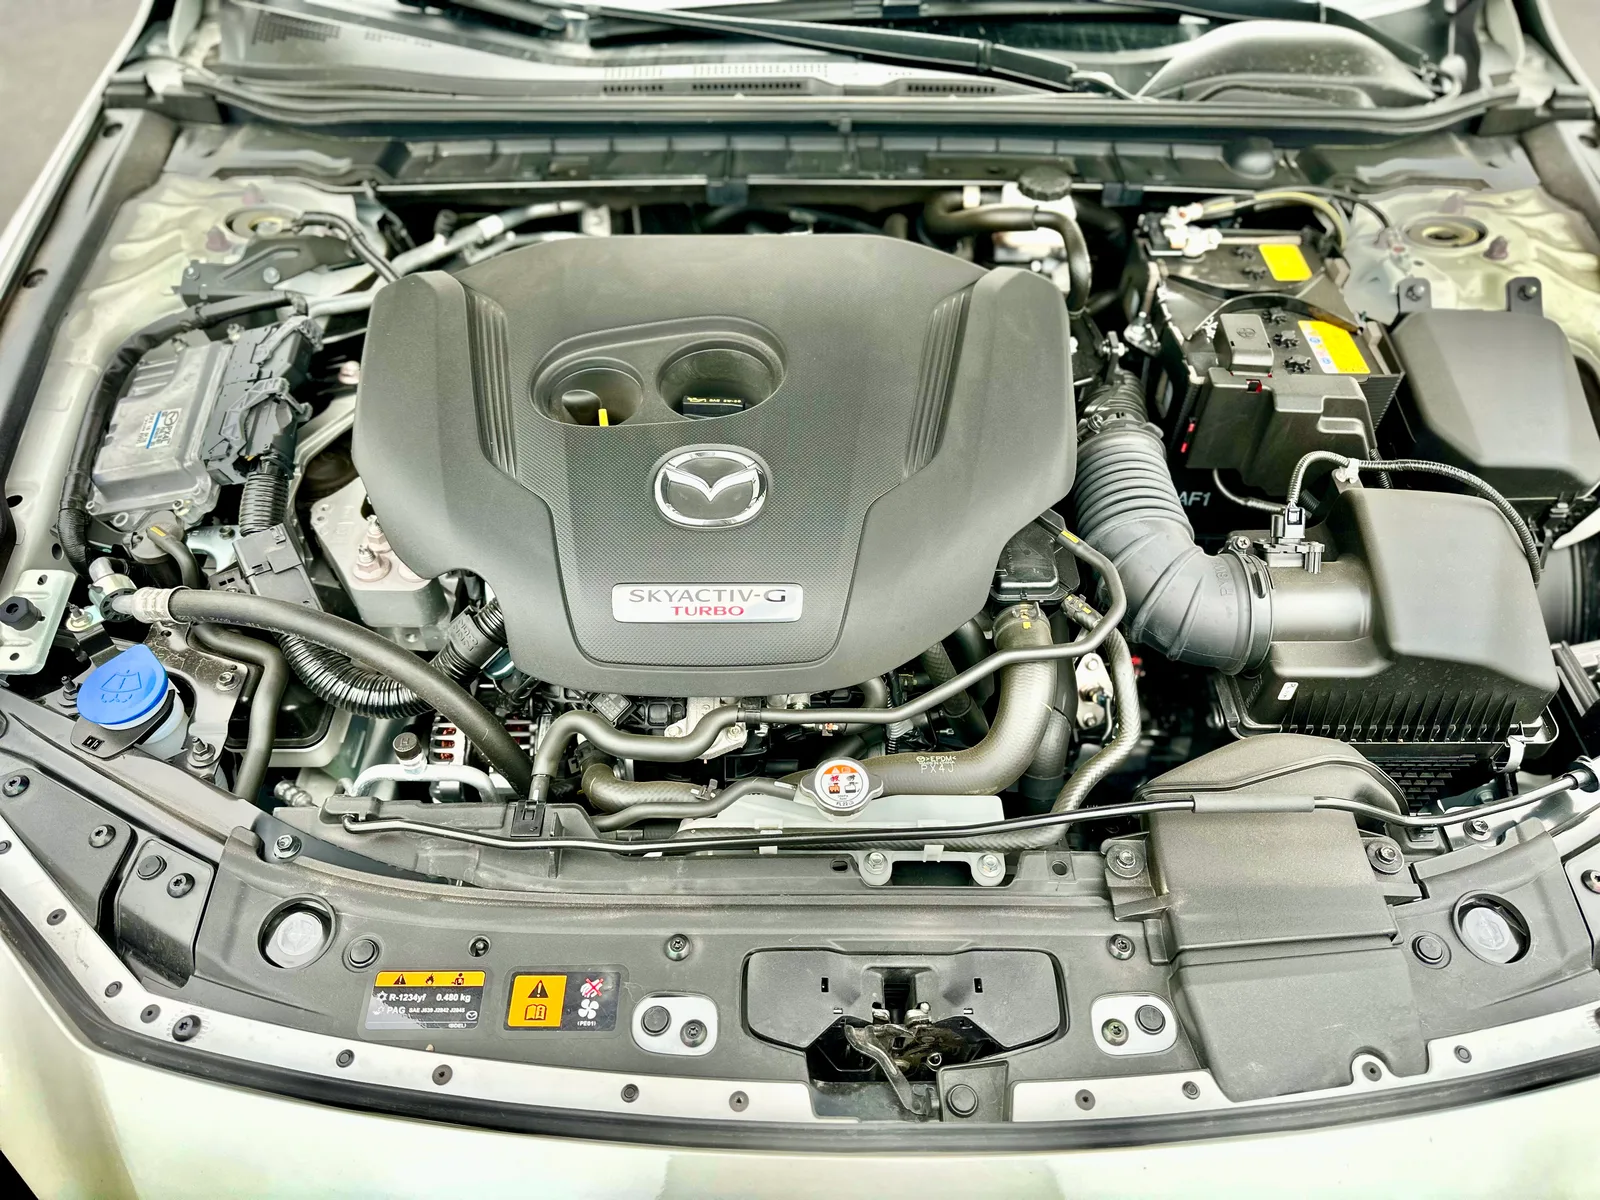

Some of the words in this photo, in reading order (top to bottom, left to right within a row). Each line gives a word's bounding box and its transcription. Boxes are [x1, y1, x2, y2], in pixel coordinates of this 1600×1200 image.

[629, 589, 786, 603] SKYACTIV-G
[671, 606, 744, 616] TURBO
[921, 763, 954, 774] PX4J
[389, 993, 427, 1003] R-1234yf
[436, 993, 459, 1001] 0.480
[460, 993, 471, 1003] kg
[386, 1006, 406, 1014] PAG
